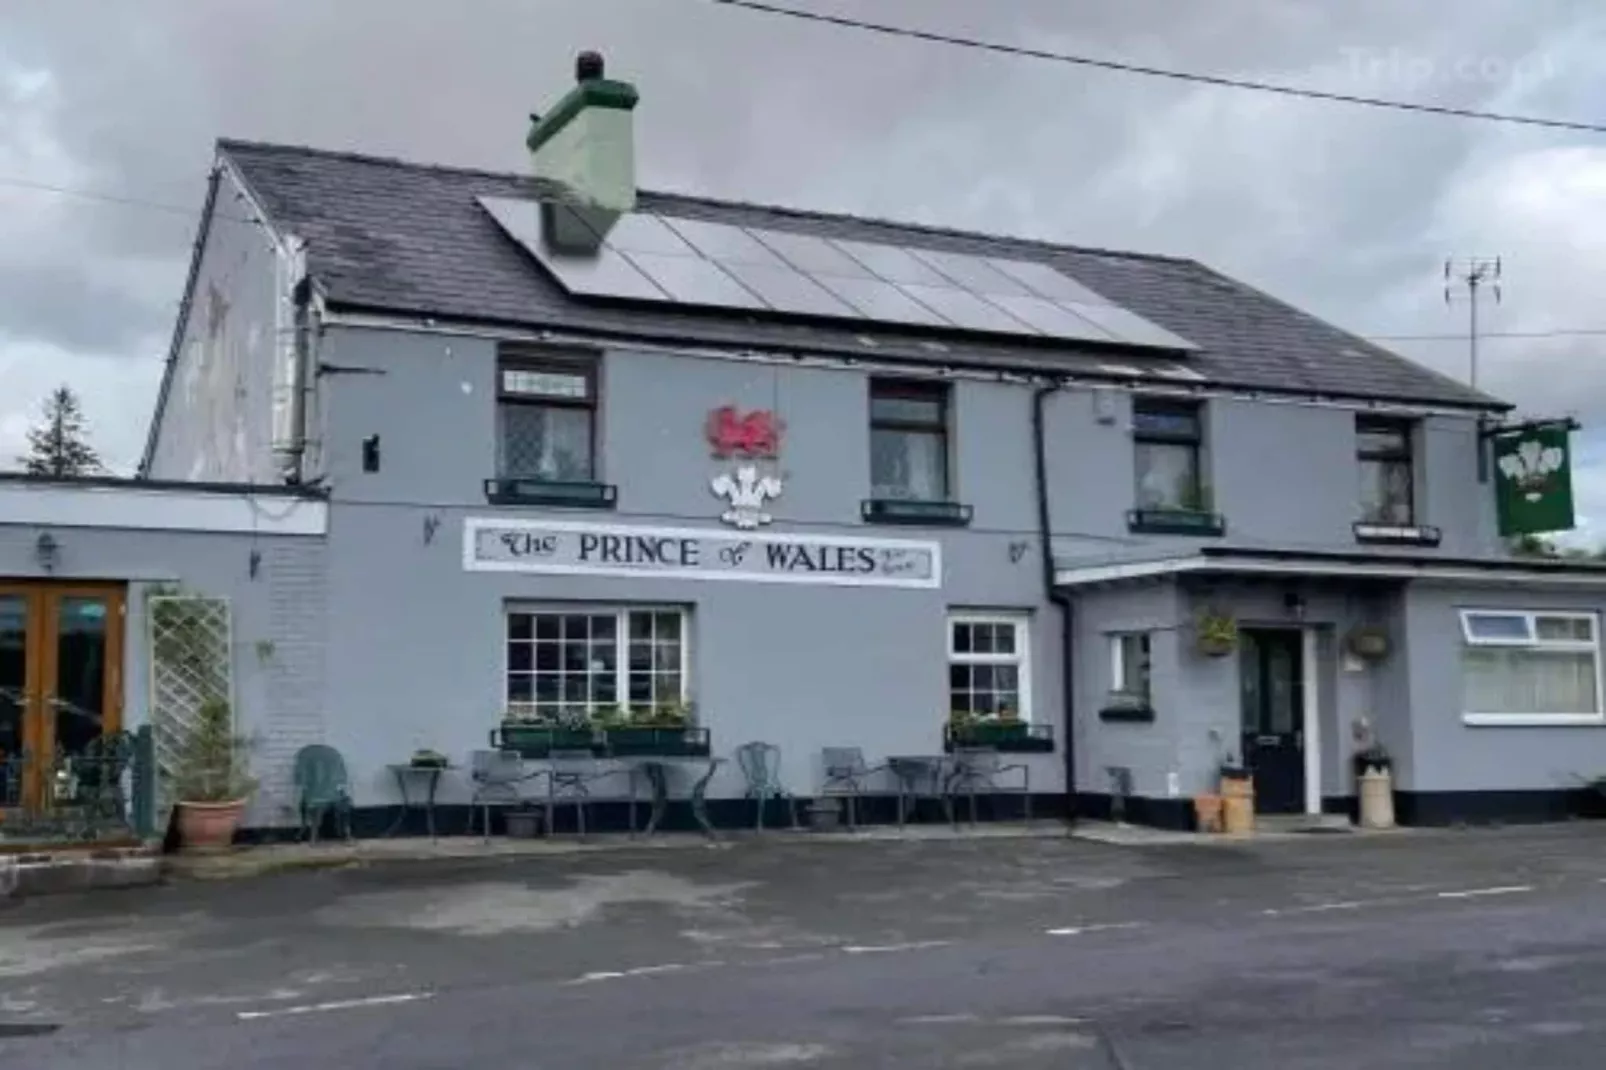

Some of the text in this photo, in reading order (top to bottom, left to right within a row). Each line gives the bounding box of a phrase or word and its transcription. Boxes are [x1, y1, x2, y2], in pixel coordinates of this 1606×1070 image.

[500, 532, 557, 557] The
[578, 533, 700, 566] PRINCE
[766, 543, 875, 573] WALES
